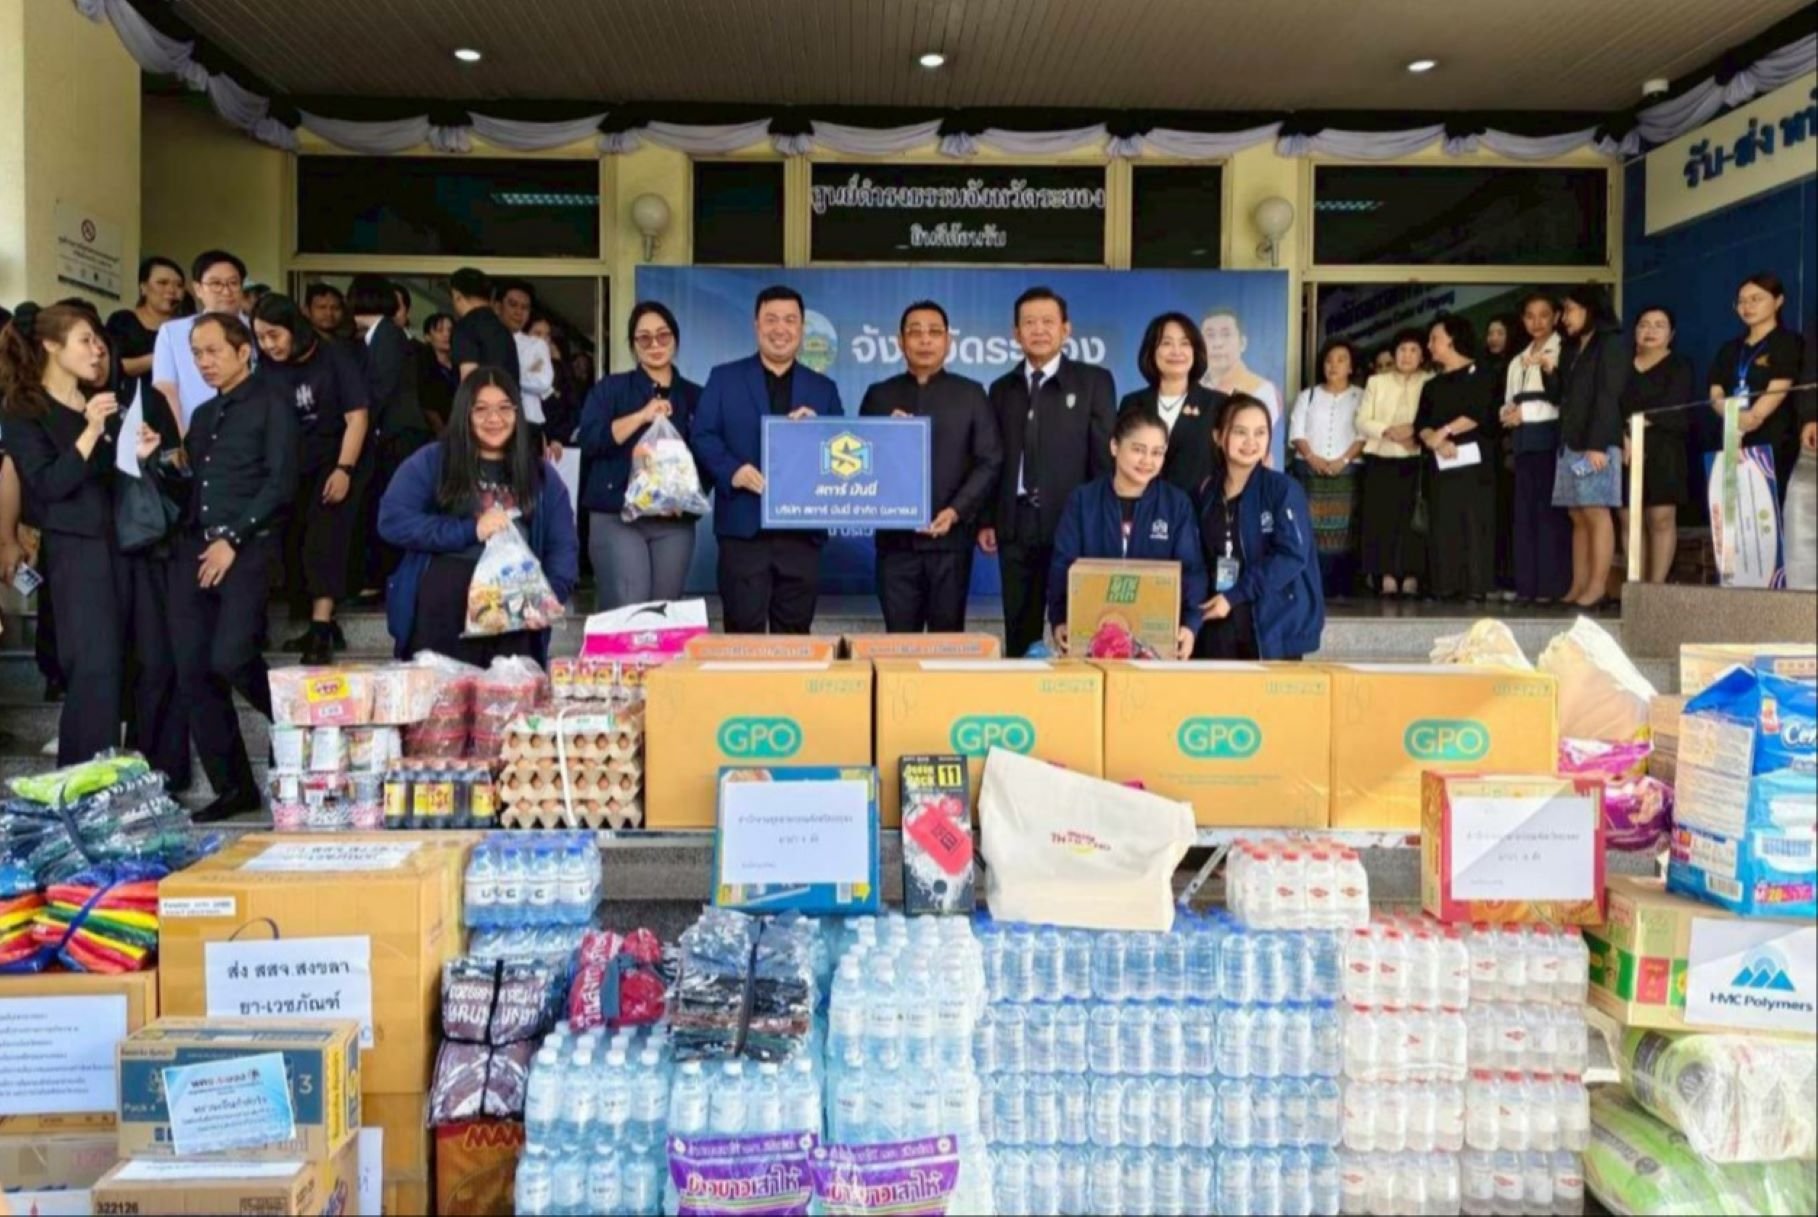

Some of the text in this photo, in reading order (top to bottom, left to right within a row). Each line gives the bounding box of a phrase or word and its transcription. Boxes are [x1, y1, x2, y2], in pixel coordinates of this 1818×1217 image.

[724, 723, 795, 752] GPO
[957, 718, 1028, 747] GPO
[1183, 723, 1255, 752] GPO
[1411, 725, 1482, 754] GPO
[940, 766, 958, 785] 11
[227, 959, 249, 979] ส่ง
[239, 990, 341, 1016] ยา-เวชภัณฑ์
[1709, 991, 1814, 1014] HMC Polymers
[299, 1073, 314, 1095] 3
